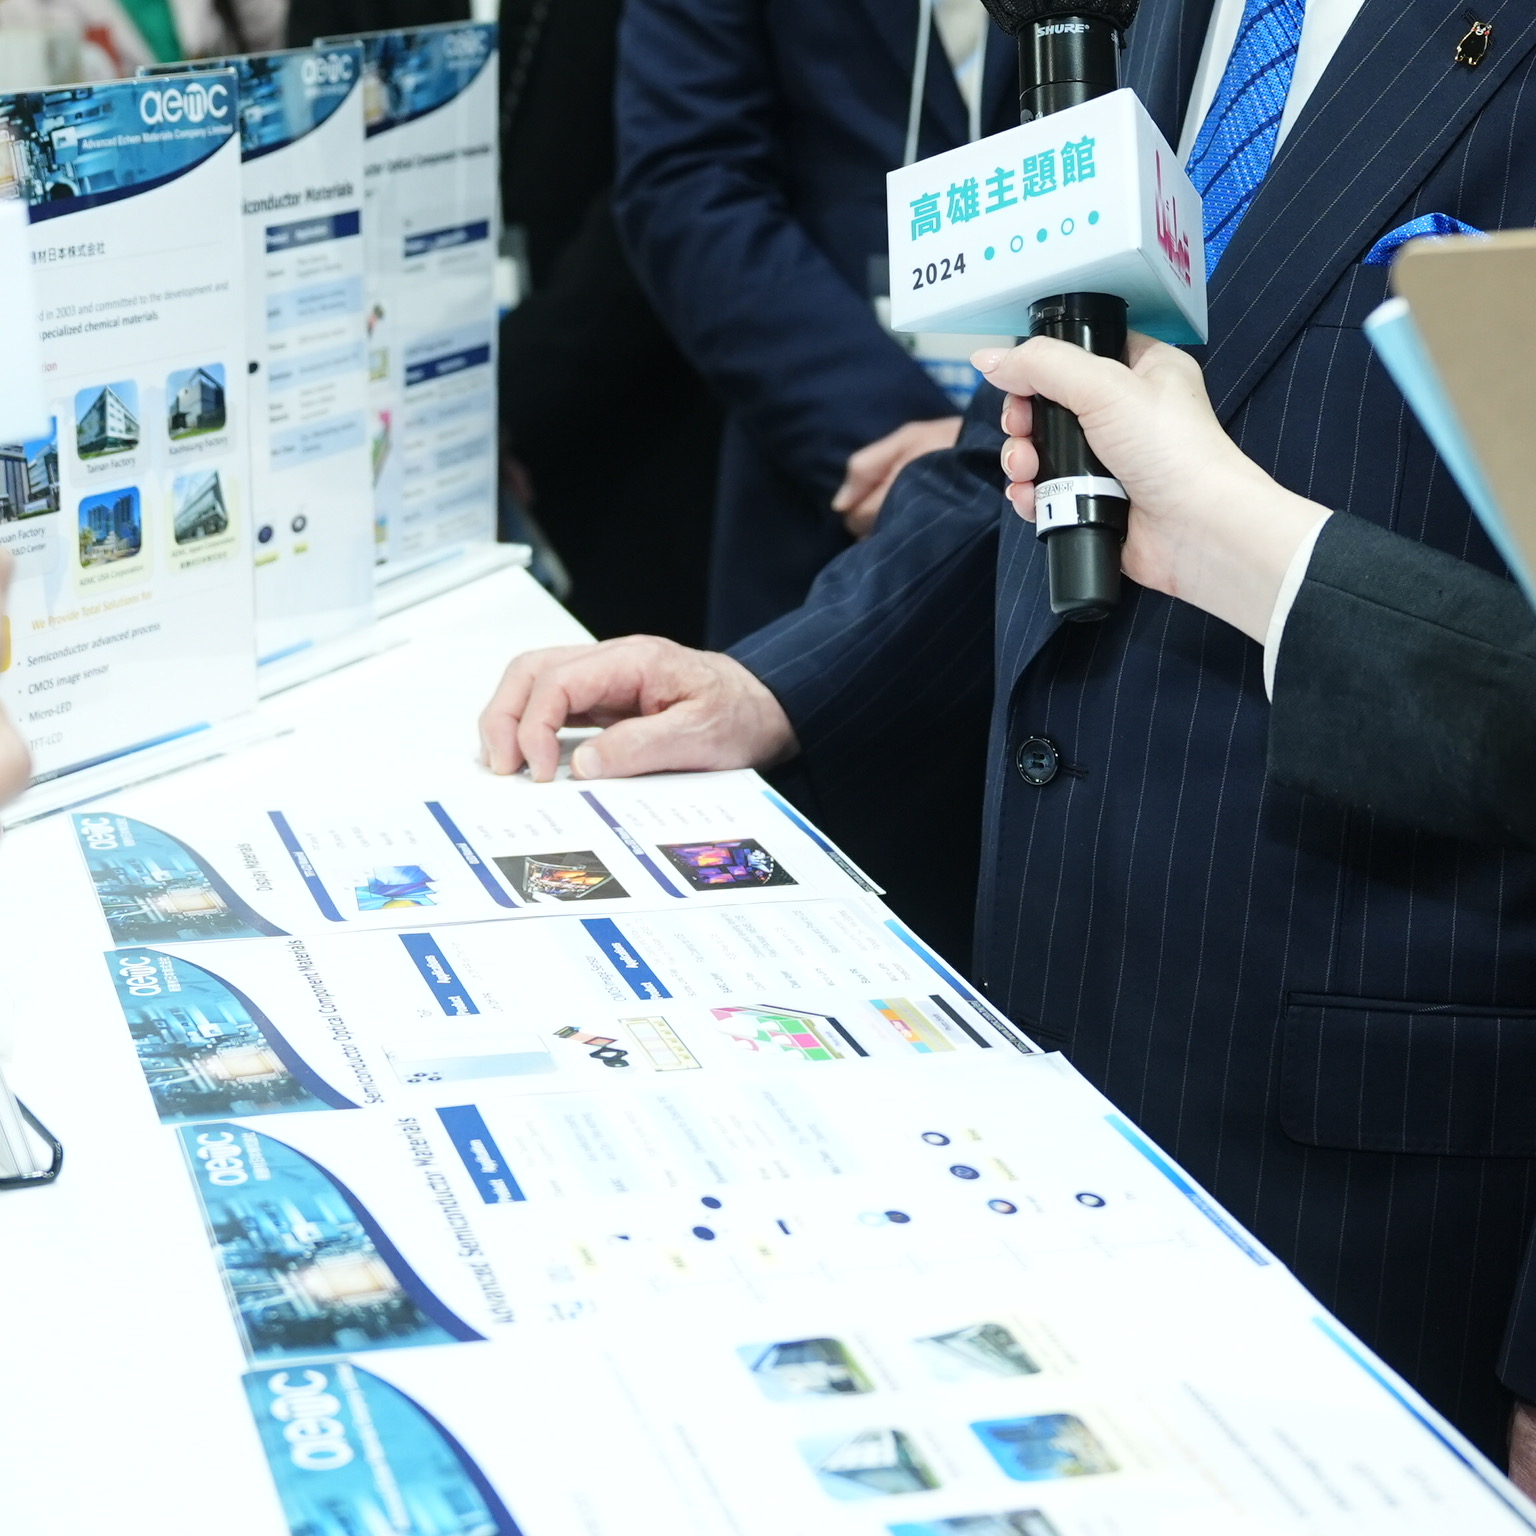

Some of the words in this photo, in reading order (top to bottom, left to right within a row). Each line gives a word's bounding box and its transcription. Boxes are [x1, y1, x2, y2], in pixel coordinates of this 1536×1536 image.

[1037, 24, 1084, 37] SHURE
[139, 79, 229, 128] aemc
[910, 135, 1096, 241] 高雄主題館
[912, 253, 966, 291] 2024
[78, 302, 92, 316] and
[95, 294, 137, 313] committed
[150, 290, 161, 304] the
[84, 315, 120, 333] chemical
[86, 459, 108, 475] Tainan
[110, 453, 135, 472] Factory
[1046, 503, 1053, 519] 1
[18, 523, 45, 543] Factory
[31, 616, 47, 632] We
[49, 606, 79, 628] Provide
[81, 600, 101, 618] Total
[103, 589, 139, 612] Solutions
[27, 638, 88, 669] Semiconductor
[92, 627, 129, 650] advanced
[131, 619, 161, 639] process
[28, 676, 54, 696] CMOS
[56, 668, 80, 689] image
[82, 661, 109, 679] sensor
[29, 698, 72, 724] Micro-LED
[234, 842, 263, 869] Materials
[247, 870, 276, 891] Display
[283, 939, 318, 971] Materials
[579, 954, 606, 971] Sensor
[606, 941, 642, 968] Applications
[114, 955, 166, 997] aemc
[420, 954, 454, 984] Applications
[593, 971, 619, 986] Image
[299, 972, 343, 1013] Component
[603, 986, 628, 1001] CMOS
[638, 981, 665, 1000] Product
[714, 981, 734, 993] BARC
[445, 995, 472, 1015] Product
[320, 1014, 357, 1041] Optical
[333, 1042, 386, 1104] Semiconductor
[392, 1116, 440, 1167] Materials
[190, 1130, 254, 1187] aemc
[418, 1169, 485, 1257] Semiconductor
[461, 1260, 518, 1325] Advanced
[259, 1370, 363, 1473] aemc
